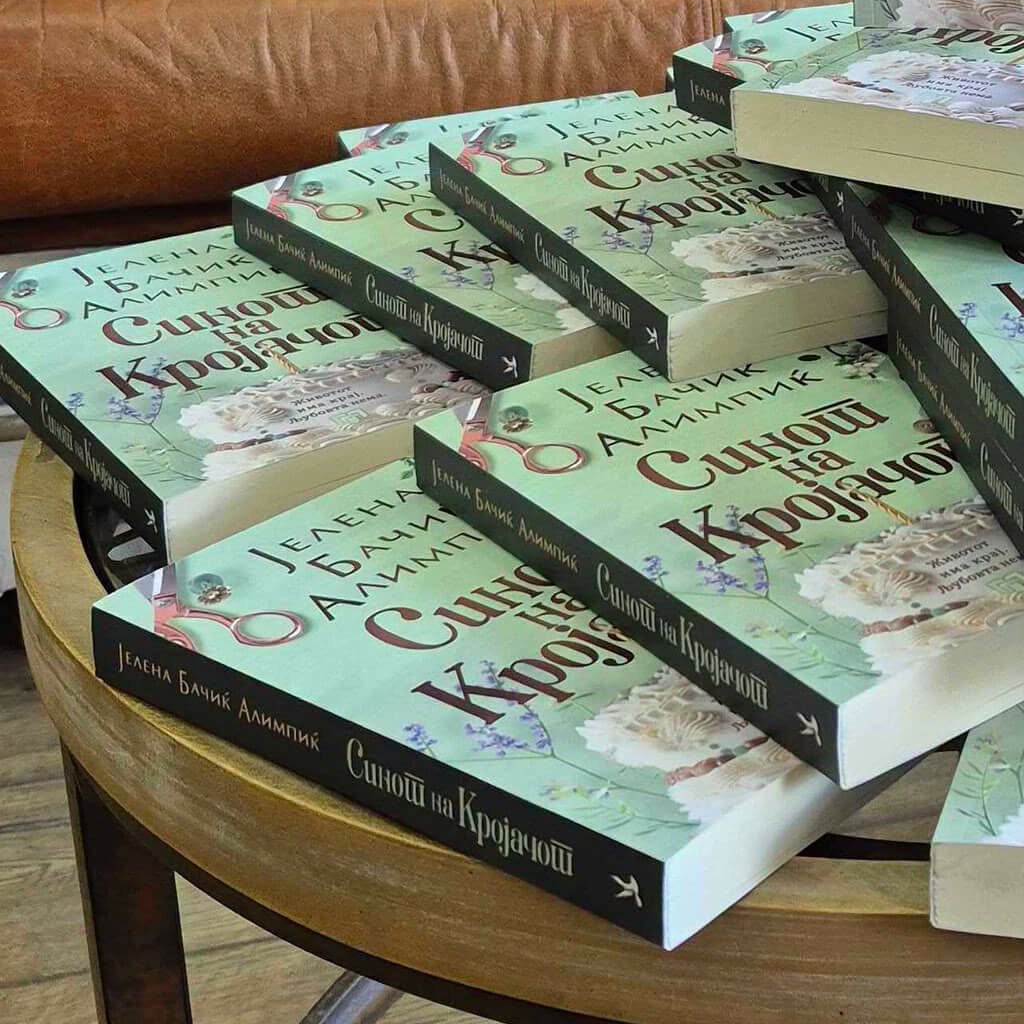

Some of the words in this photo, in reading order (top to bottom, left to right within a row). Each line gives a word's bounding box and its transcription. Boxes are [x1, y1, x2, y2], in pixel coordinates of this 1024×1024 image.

[562, 127, 729, 167] АЛИМПИ
[584, 148, 743, 190] Сино
[688, 171, 752, 193] на
[211, 319, 282, 345] на
[770, 449, 855, 485] на
[432, 789, 453, 818] на
